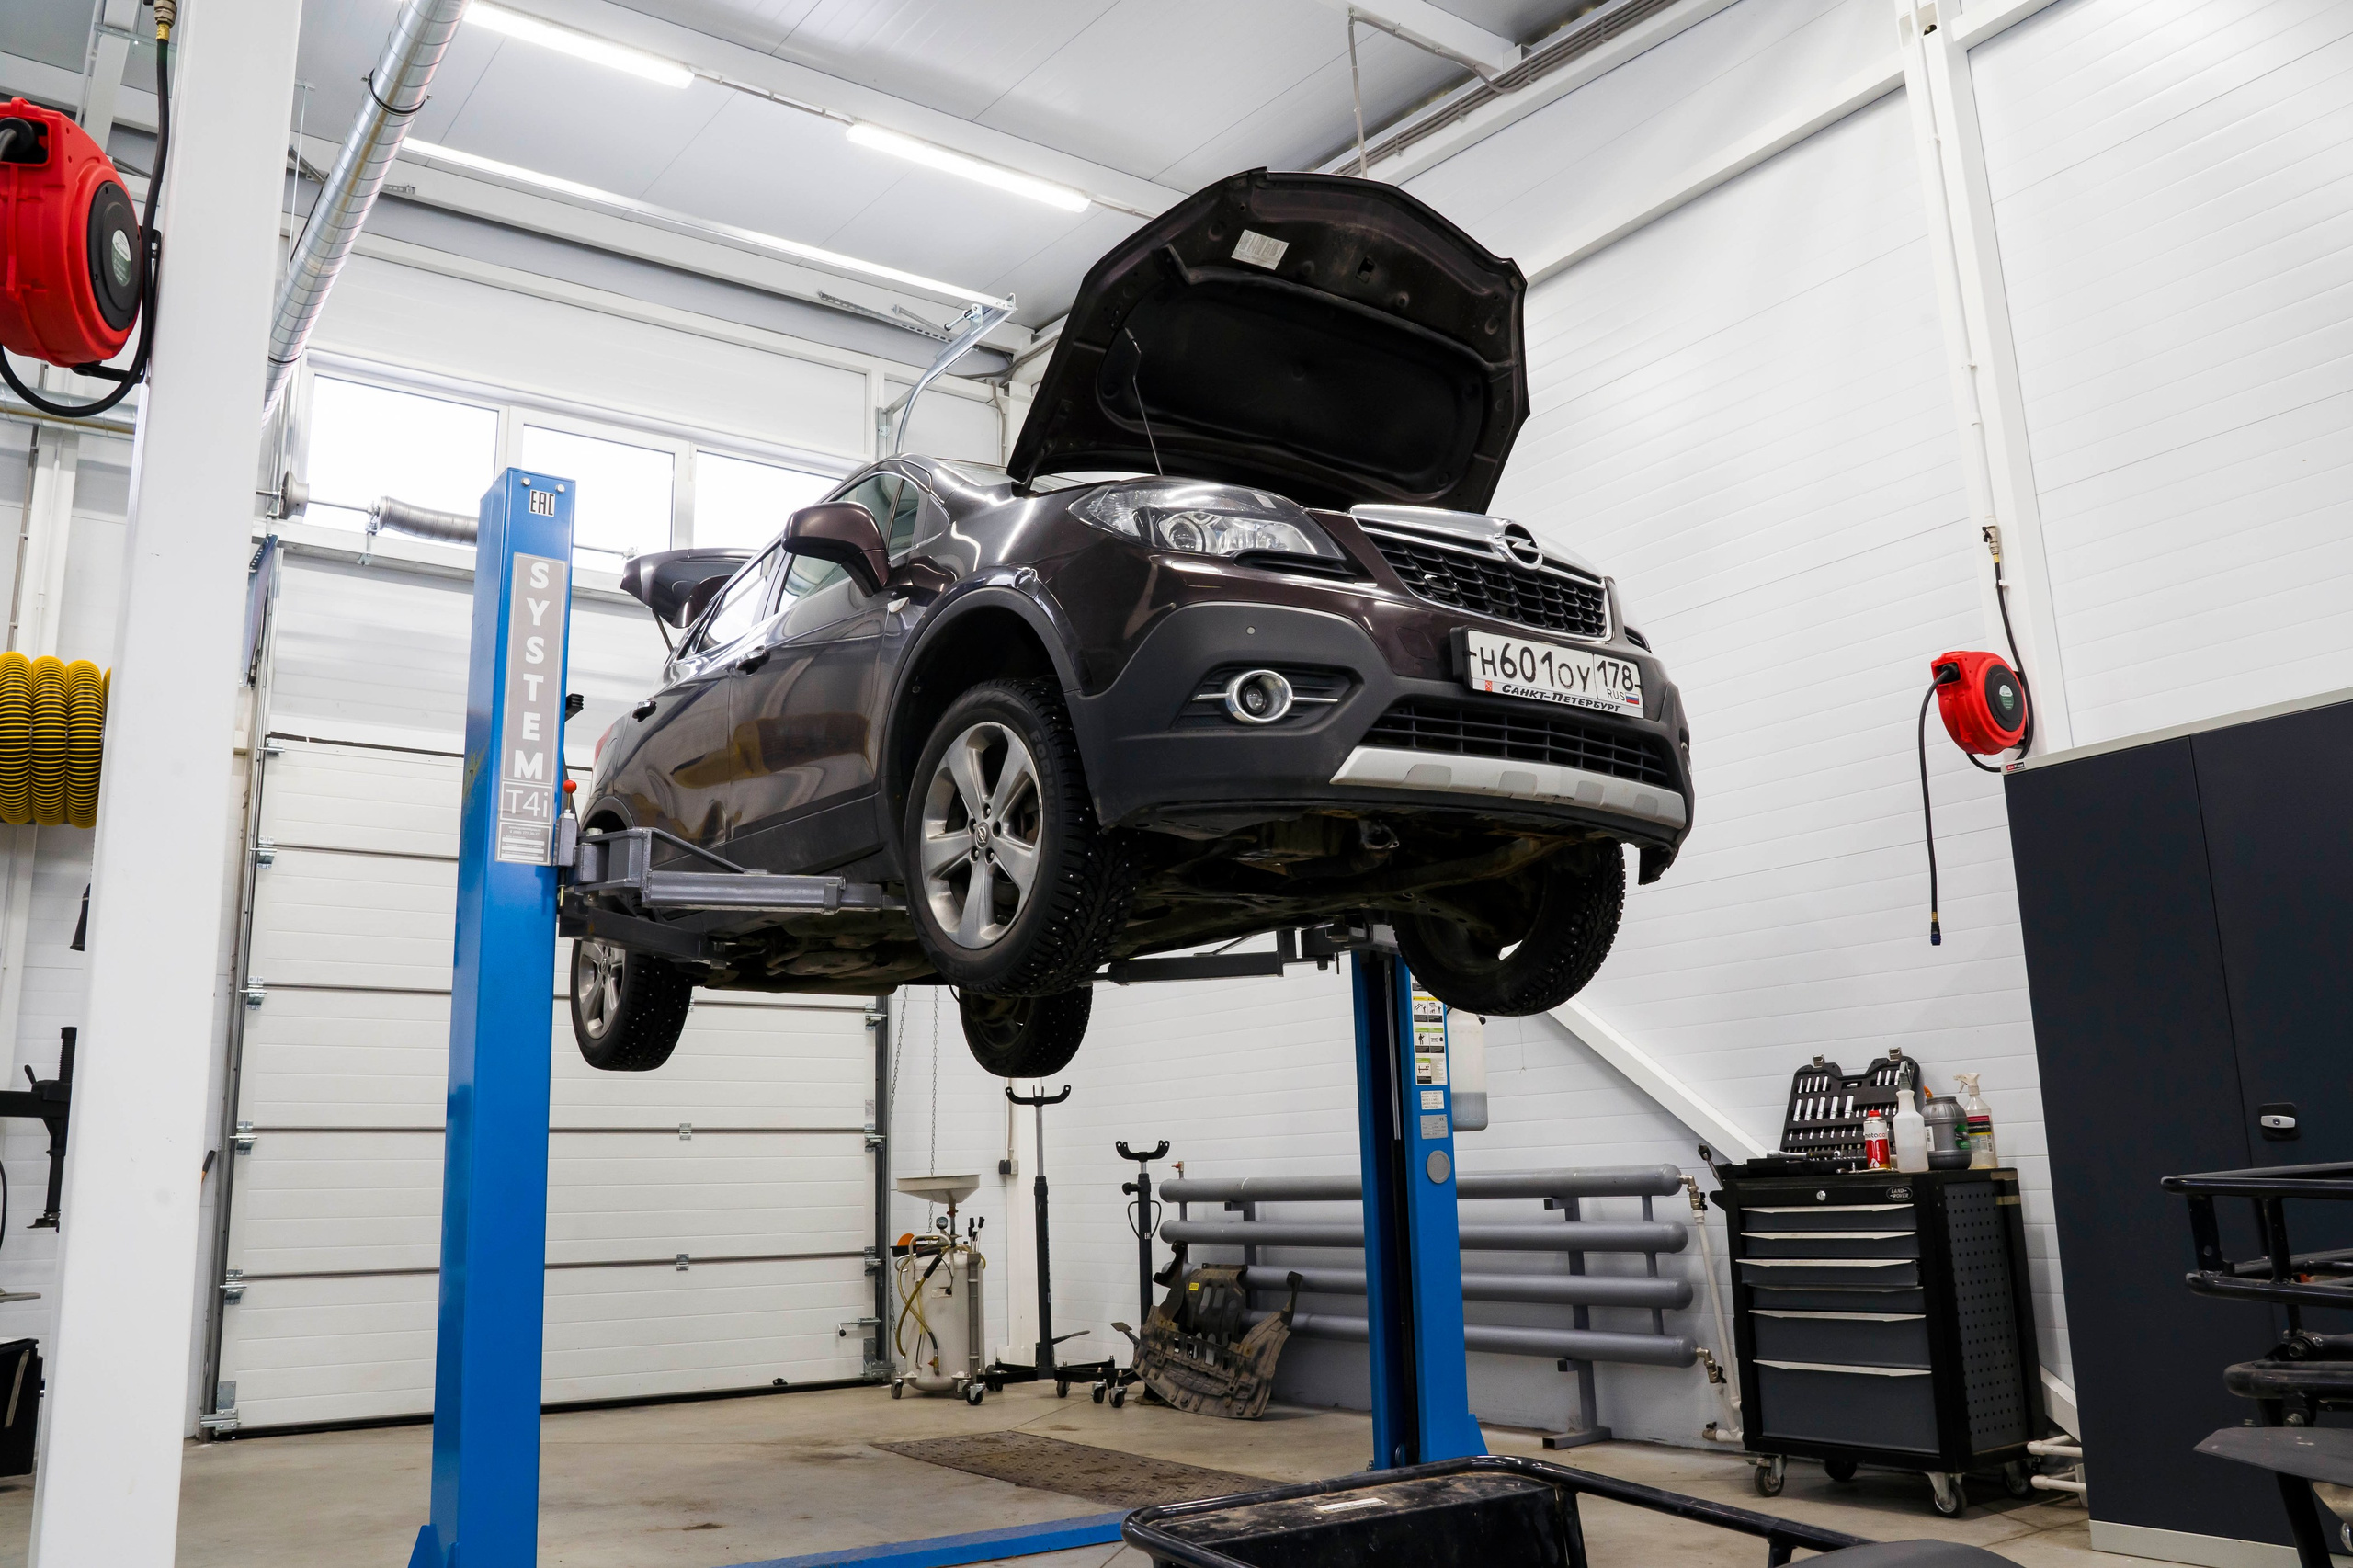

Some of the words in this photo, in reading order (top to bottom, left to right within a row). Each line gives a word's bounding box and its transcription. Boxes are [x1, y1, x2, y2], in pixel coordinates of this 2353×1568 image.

[530, 490, 554, 516] EAC
[513, 562, 551, 780] SYSTEM
[1597, 660, 1633, 691] 178
[1607, 688, 1625, 701] RUS
[506, 789, 549, 818] T4i
